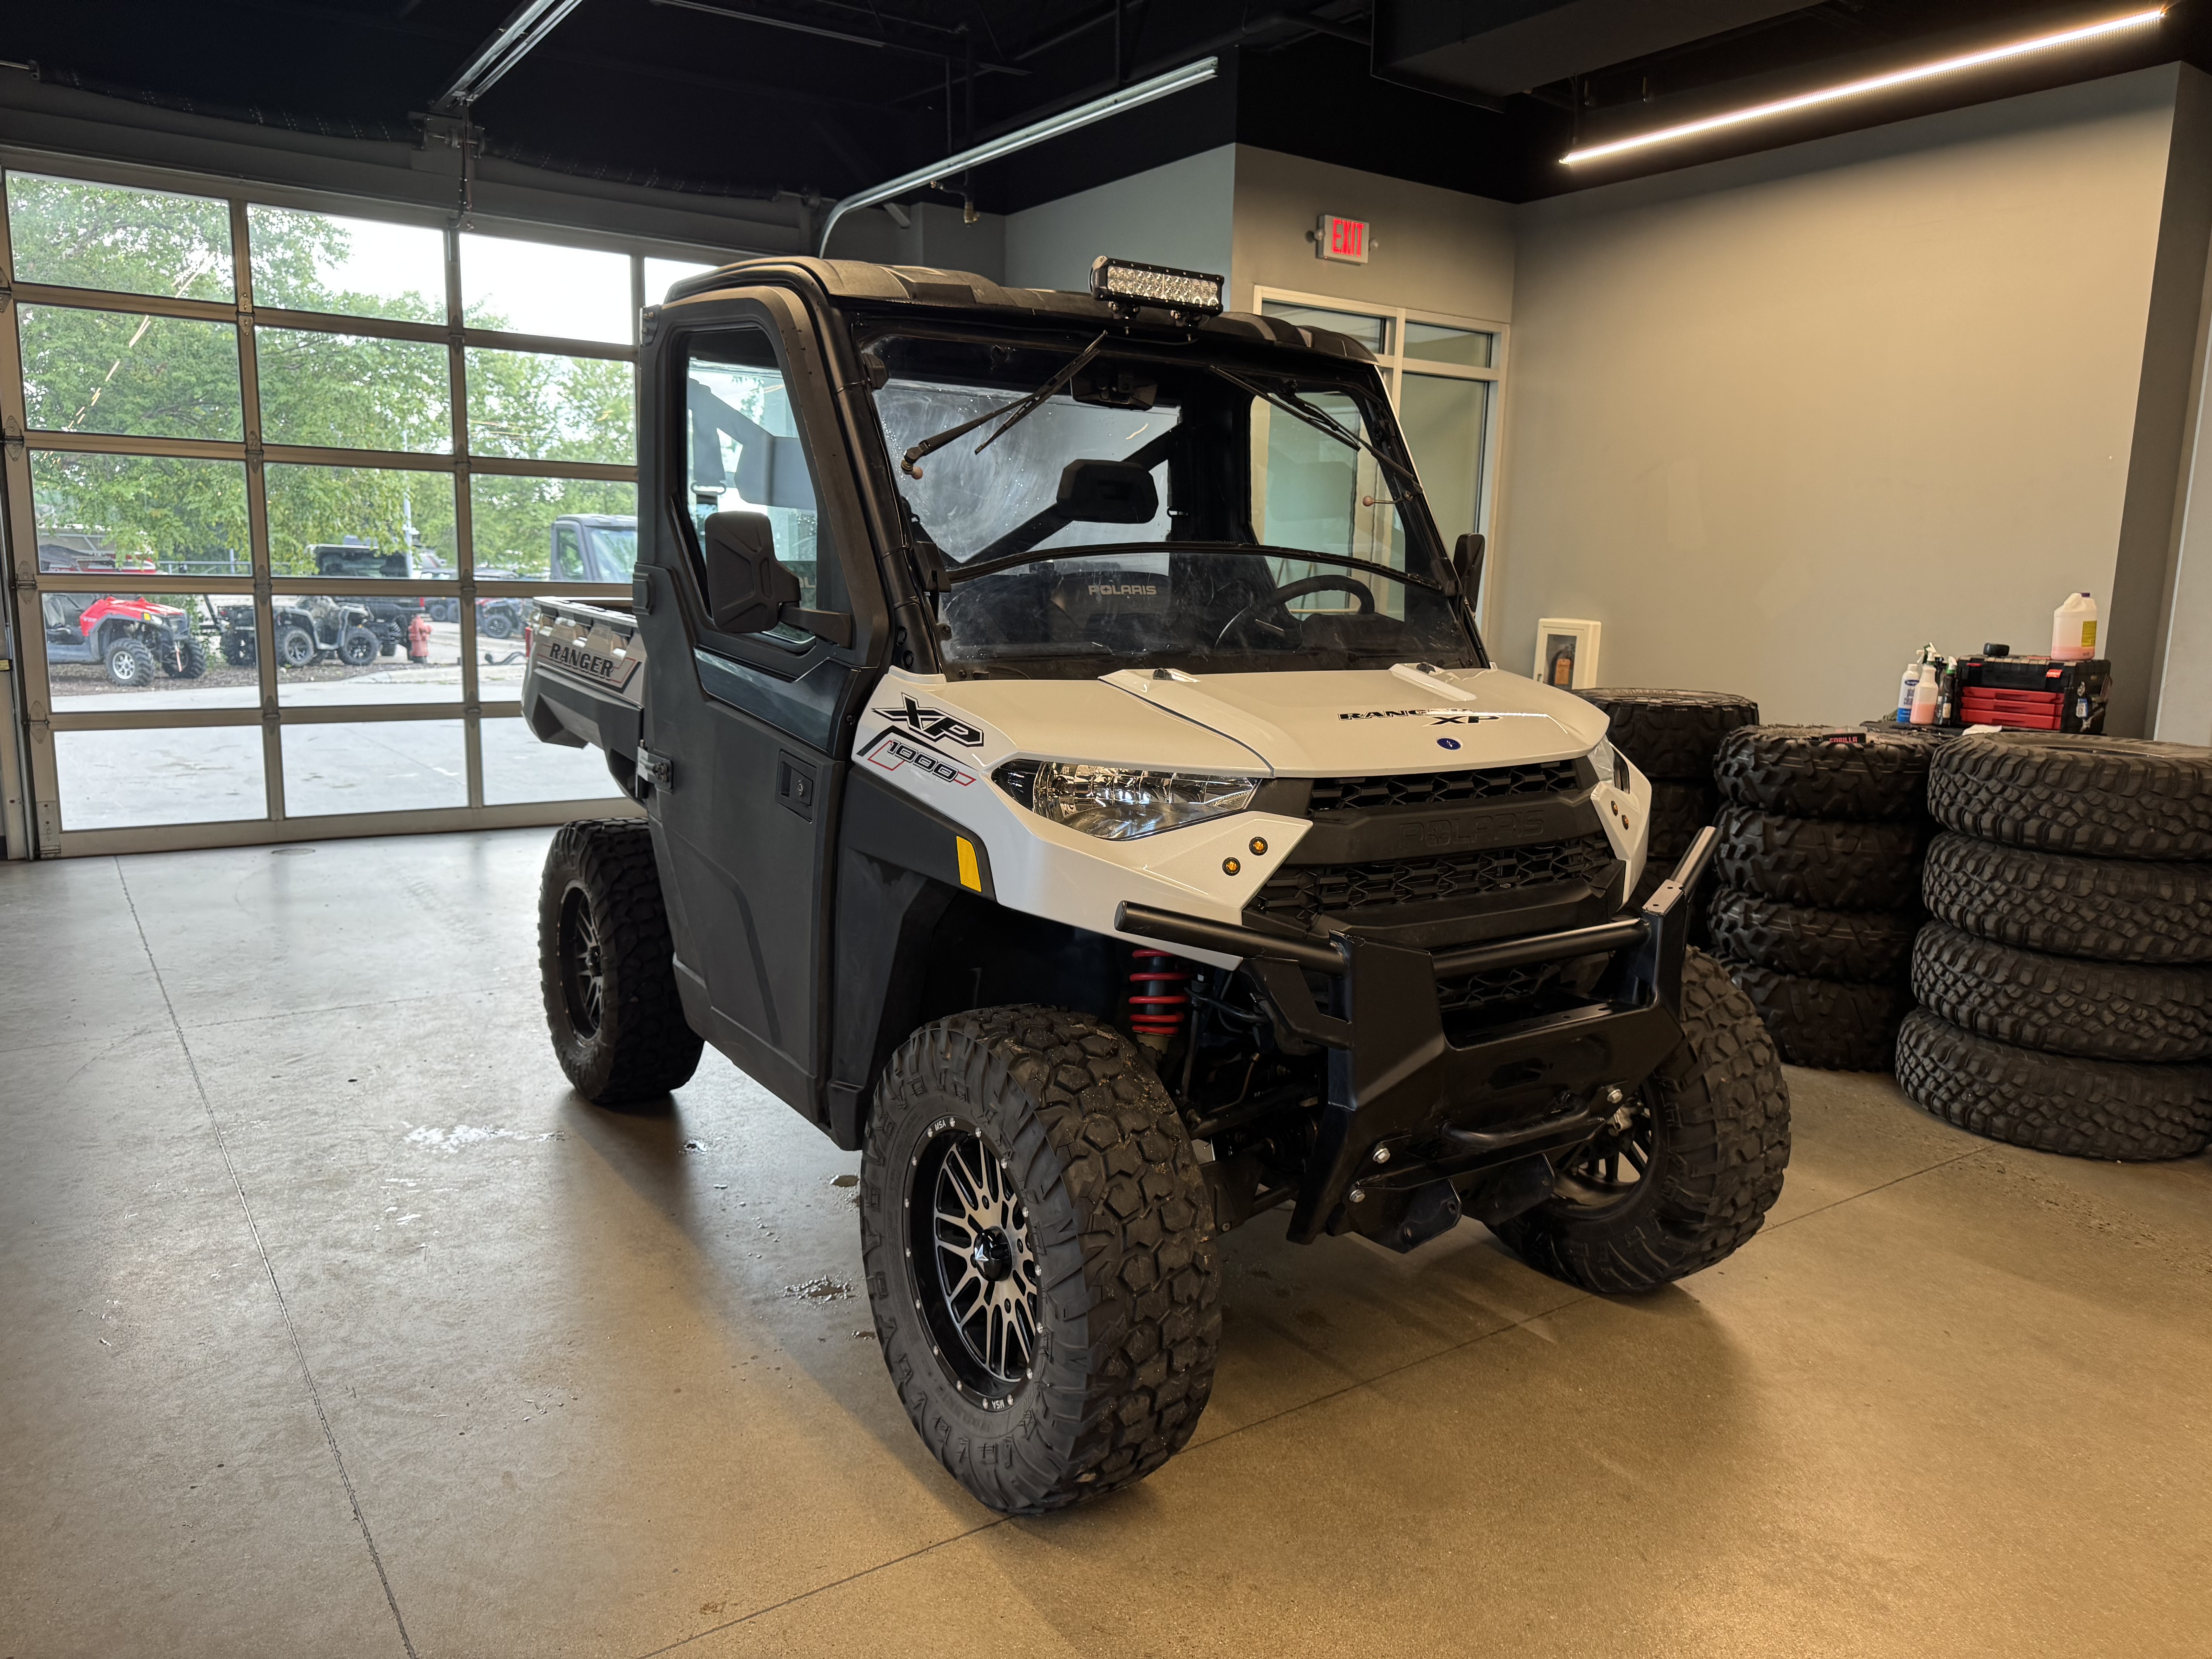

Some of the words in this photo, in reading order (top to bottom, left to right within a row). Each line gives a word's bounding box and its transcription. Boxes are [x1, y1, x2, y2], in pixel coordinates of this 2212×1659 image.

[1332, 218, 1364, 258] EXIT
[1088, 585, 1156, 595] POLARIS
[550, 643, 614, 680] RANGER
[871, 692, 984, 748] XP
[1338, 707, 1472, 721] RANG
[1423, 715, 1503, 727] XP
[888, 739, 959, 782] 1000
[1399, 810, 1544, 848] POLARIS
[934, 1119, 946, 1131] MSA
[992, 1399, 1005, 1410] MSA
